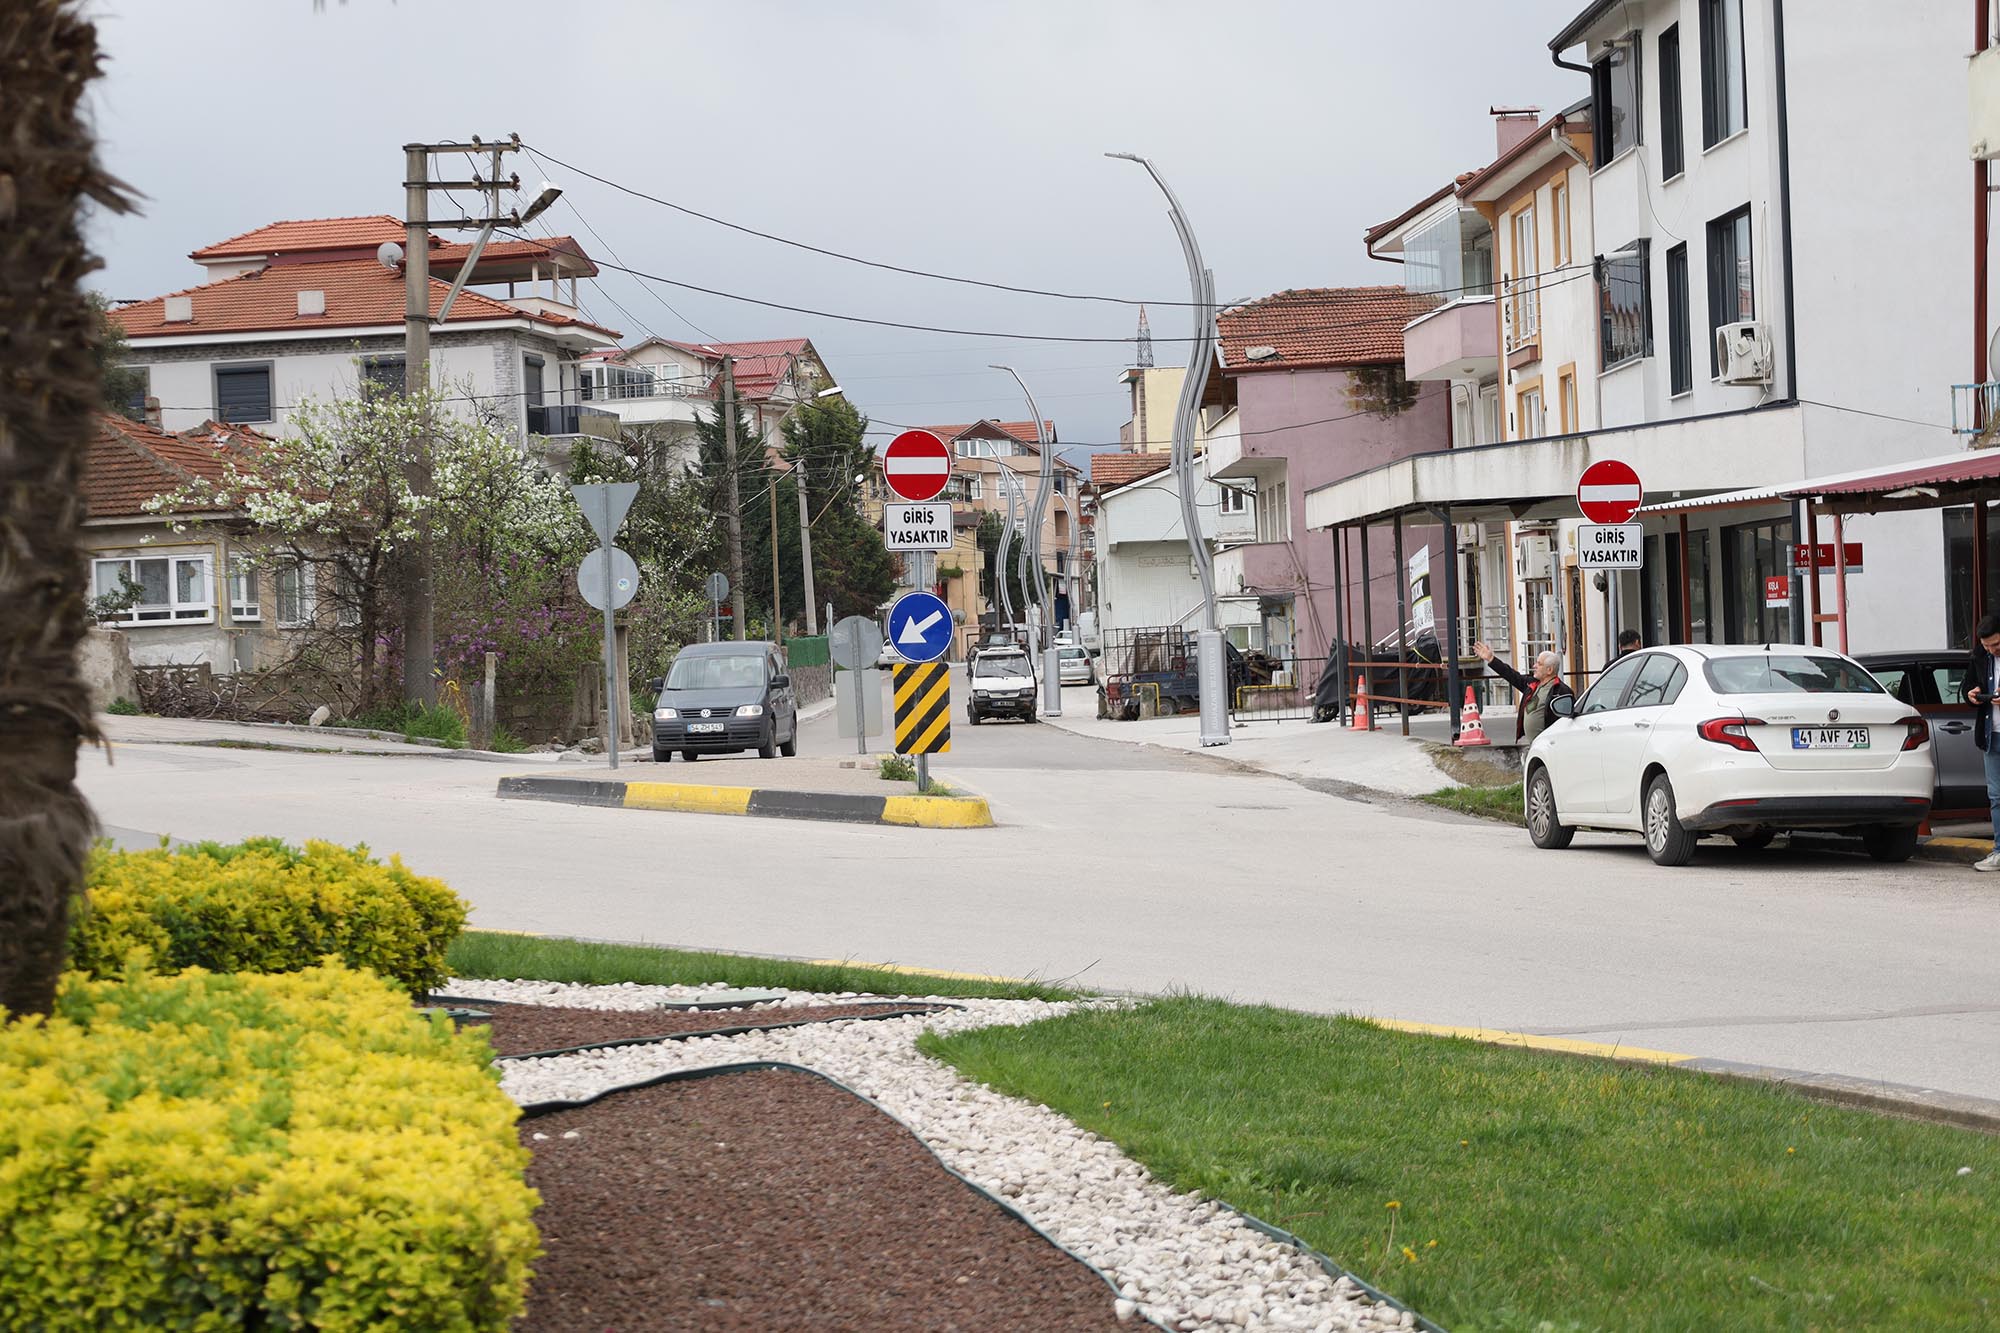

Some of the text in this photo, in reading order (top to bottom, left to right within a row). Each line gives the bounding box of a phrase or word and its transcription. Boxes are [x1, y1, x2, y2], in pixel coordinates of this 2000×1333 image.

[903, 507, 934, 525] GİRİŞ
[890, 530, 948, 543] YASAKTIR
[1595, 528, 1625, 545] GİRİŞ
[1582, 550, 1638, 562] YASAKTIR
[1800, 730, 1866, 743] 41 AVF 215
